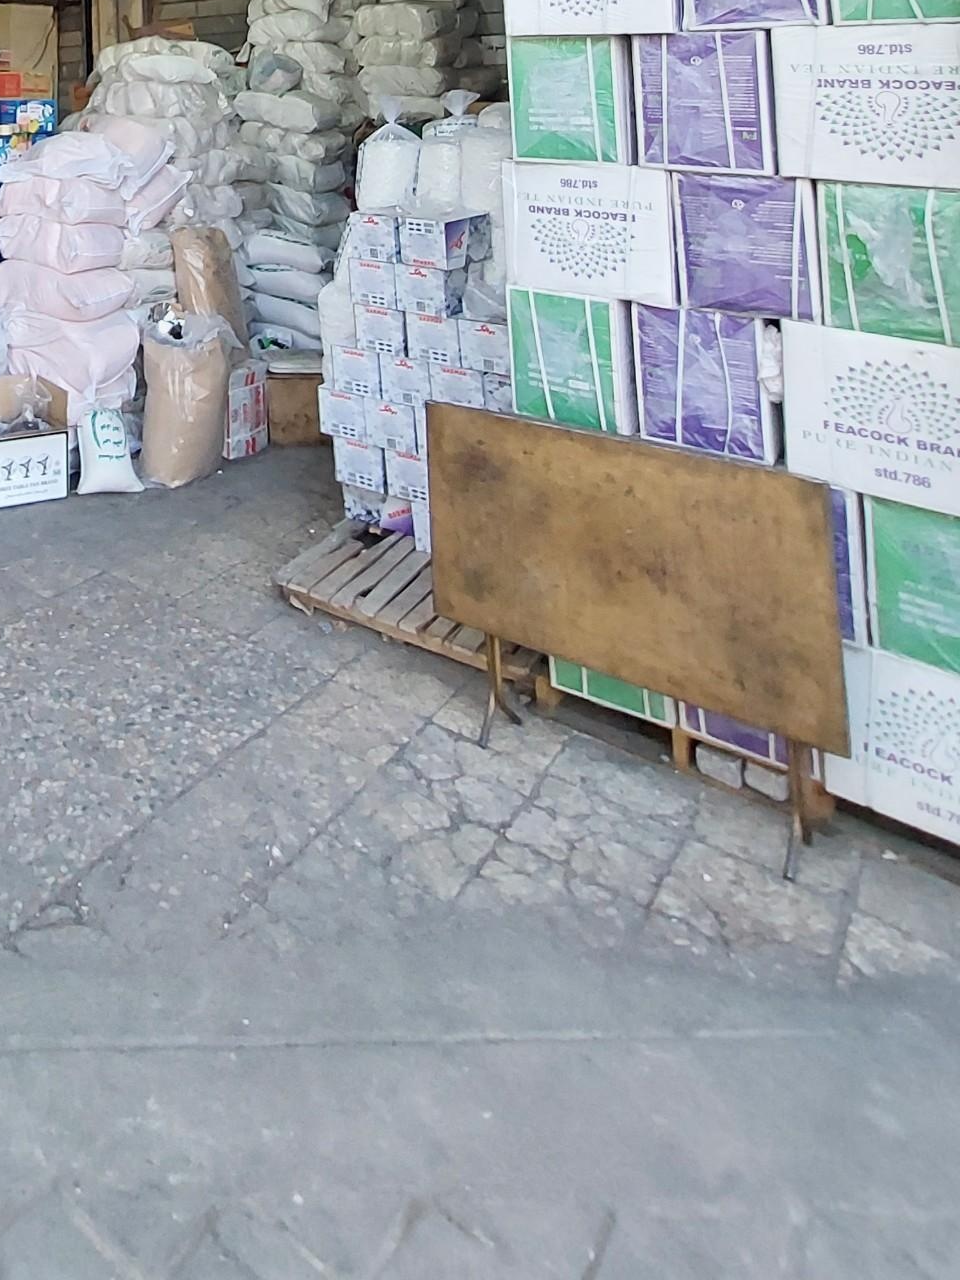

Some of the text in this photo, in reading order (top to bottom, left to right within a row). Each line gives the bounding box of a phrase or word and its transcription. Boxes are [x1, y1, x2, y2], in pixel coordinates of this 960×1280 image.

[857, 43, 913, 55] std.786
[790, 64, 960, 76] RE INDIAN TEA
[878, 79, 960, 90] EACOCK
[560, 178, 598, 189] std.786
[547, 193, 602, 206] INDIAN
[528, 205, 570, 217] BRAND
[916, 439, 960, 459] BRA
[867, 444, 953, 472] INDIAN
[874, 467, 932, 489] std.786
